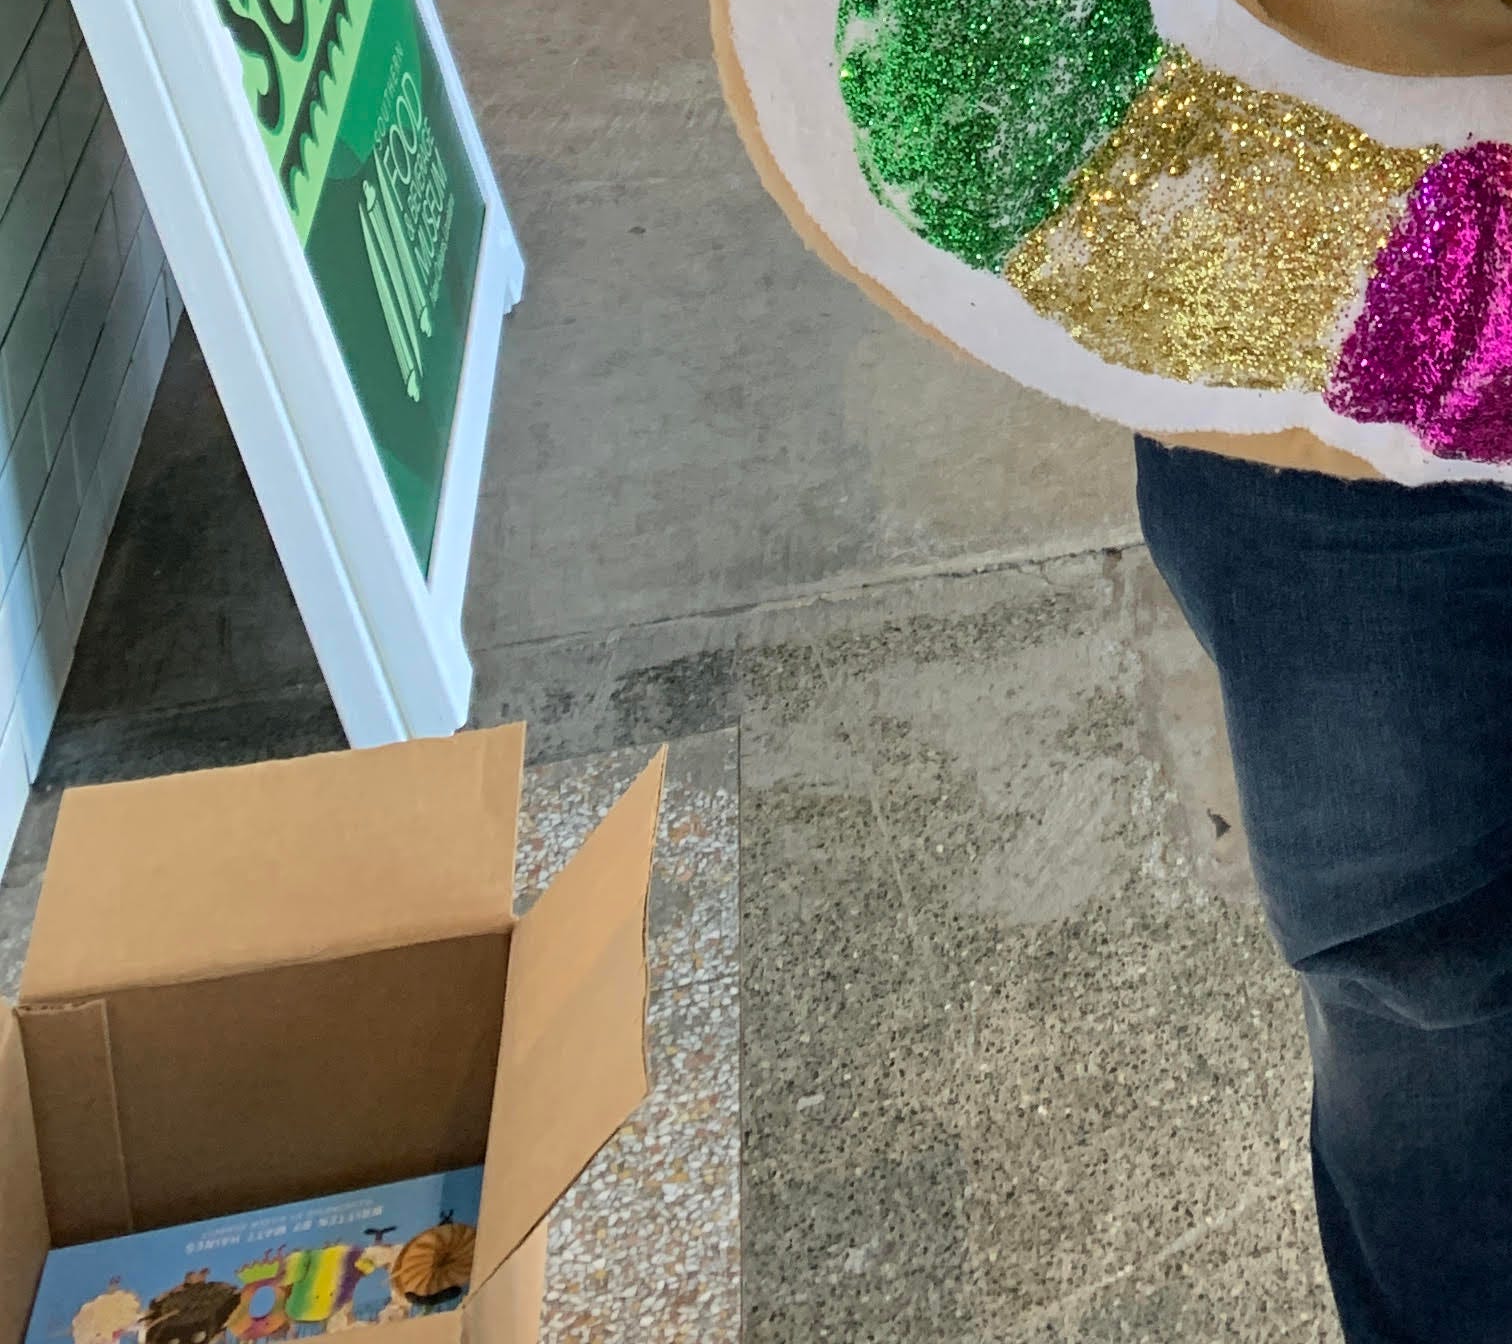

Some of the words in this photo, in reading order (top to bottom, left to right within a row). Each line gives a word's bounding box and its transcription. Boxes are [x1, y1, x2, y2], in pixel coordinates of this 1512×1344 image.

[374, 40, 404, 150] SOUTHERN
[383, 72, 422, 211] FOOD
[407, 116, 434, 224] BEVERAGE
[414, 147, 447, 285] MUSEUM
